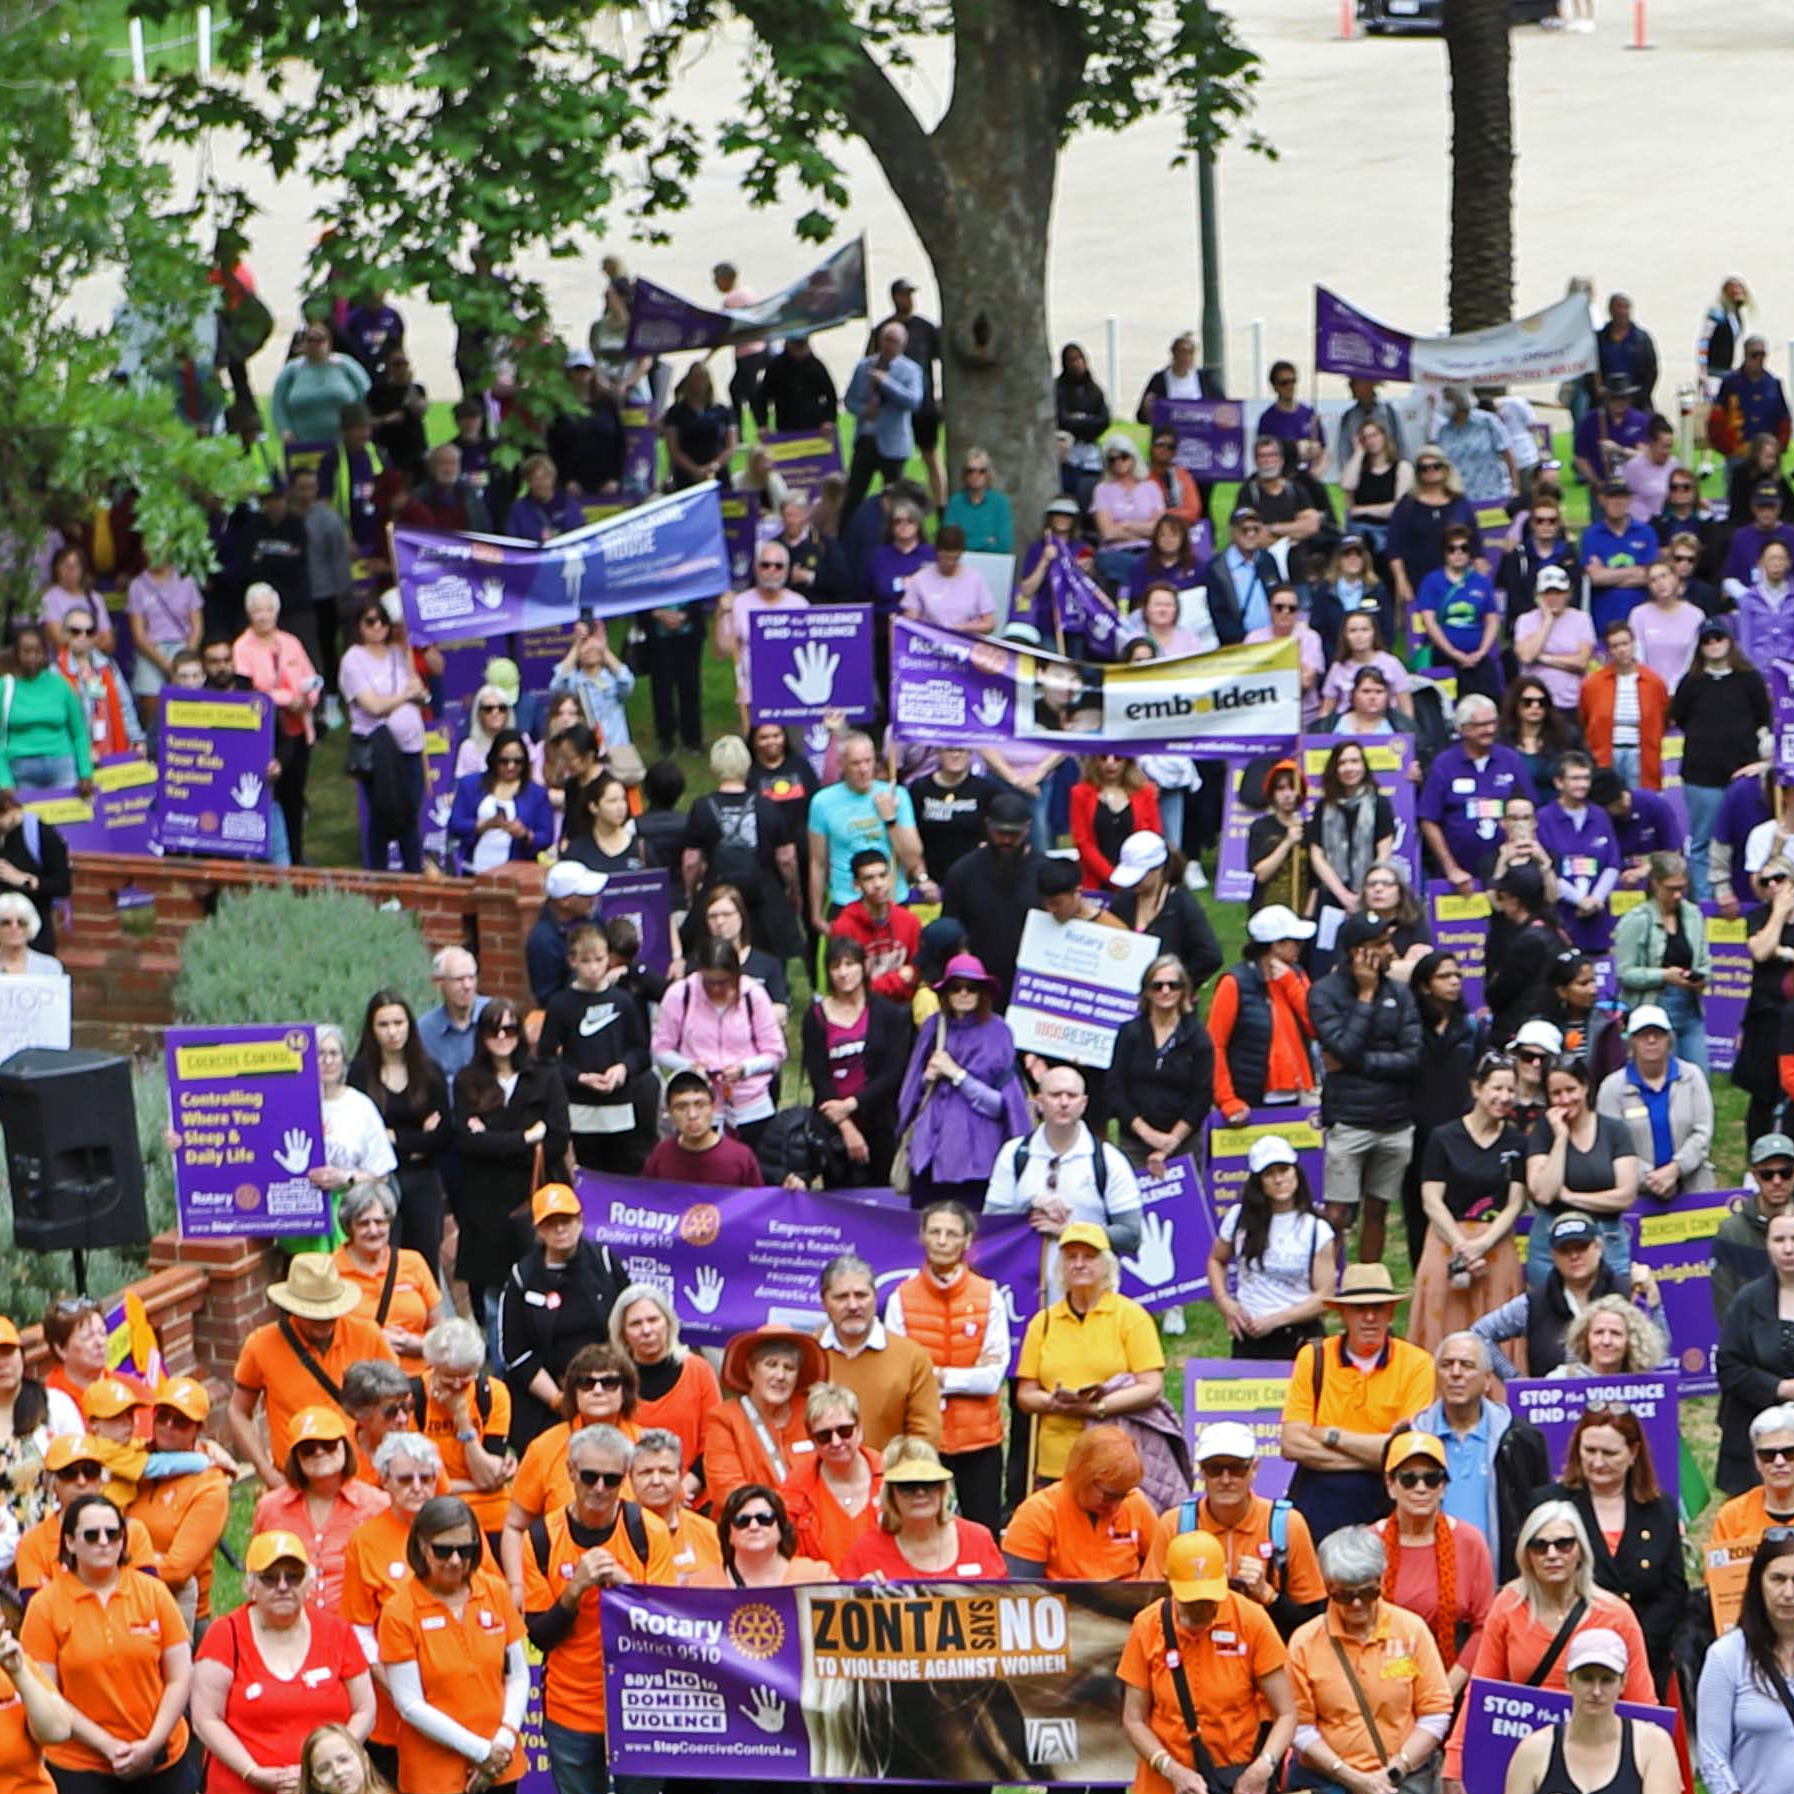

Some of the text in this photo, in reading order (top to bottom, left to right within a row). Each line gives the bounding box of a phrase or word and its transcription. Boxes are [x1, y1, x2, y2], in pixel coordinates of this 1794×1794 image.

[180, 1090, 264, 1109] Controlling
[181, 1110, 261, 1126] Where You
[184, 1129, 240, 1147] Sleep &
[185, 1147, 255, 1168] Daily Life
[191, 1191, 234, 1207] Rotary
[609, 1201, 680, 1234] Rotary
[769, 1219, 841, 1239] Empowering
[766, 1270, 819, 1288] recovery
[754, 1286, 806, 1301] domestic
[1519, 1383, 1665, 1407] STOP the VIOLENCE
[1529, 1408, 1565, 1424] END
[629, 1606, 724, 1644] Rotary
[811, 1596, 1067, 1651] ZONTA SAYS NO
[618, 1635, 722, 1665] District 9510
[816, 1654, 1067, 1679] TO VIOLENCE AGAINST WOMEN
[624, 1672, 719, 1692] says NO to
[627, 1692, 721, 1708] DOMESTIC
[1484, 1695, 1561, 1724] STOP the
[627, 1713, 722, 1728] VIOLENCE
[1492, 1718, 1534, 1739] END
[624, 1741, 798, 1757] www.StopCoerciveControl.au
